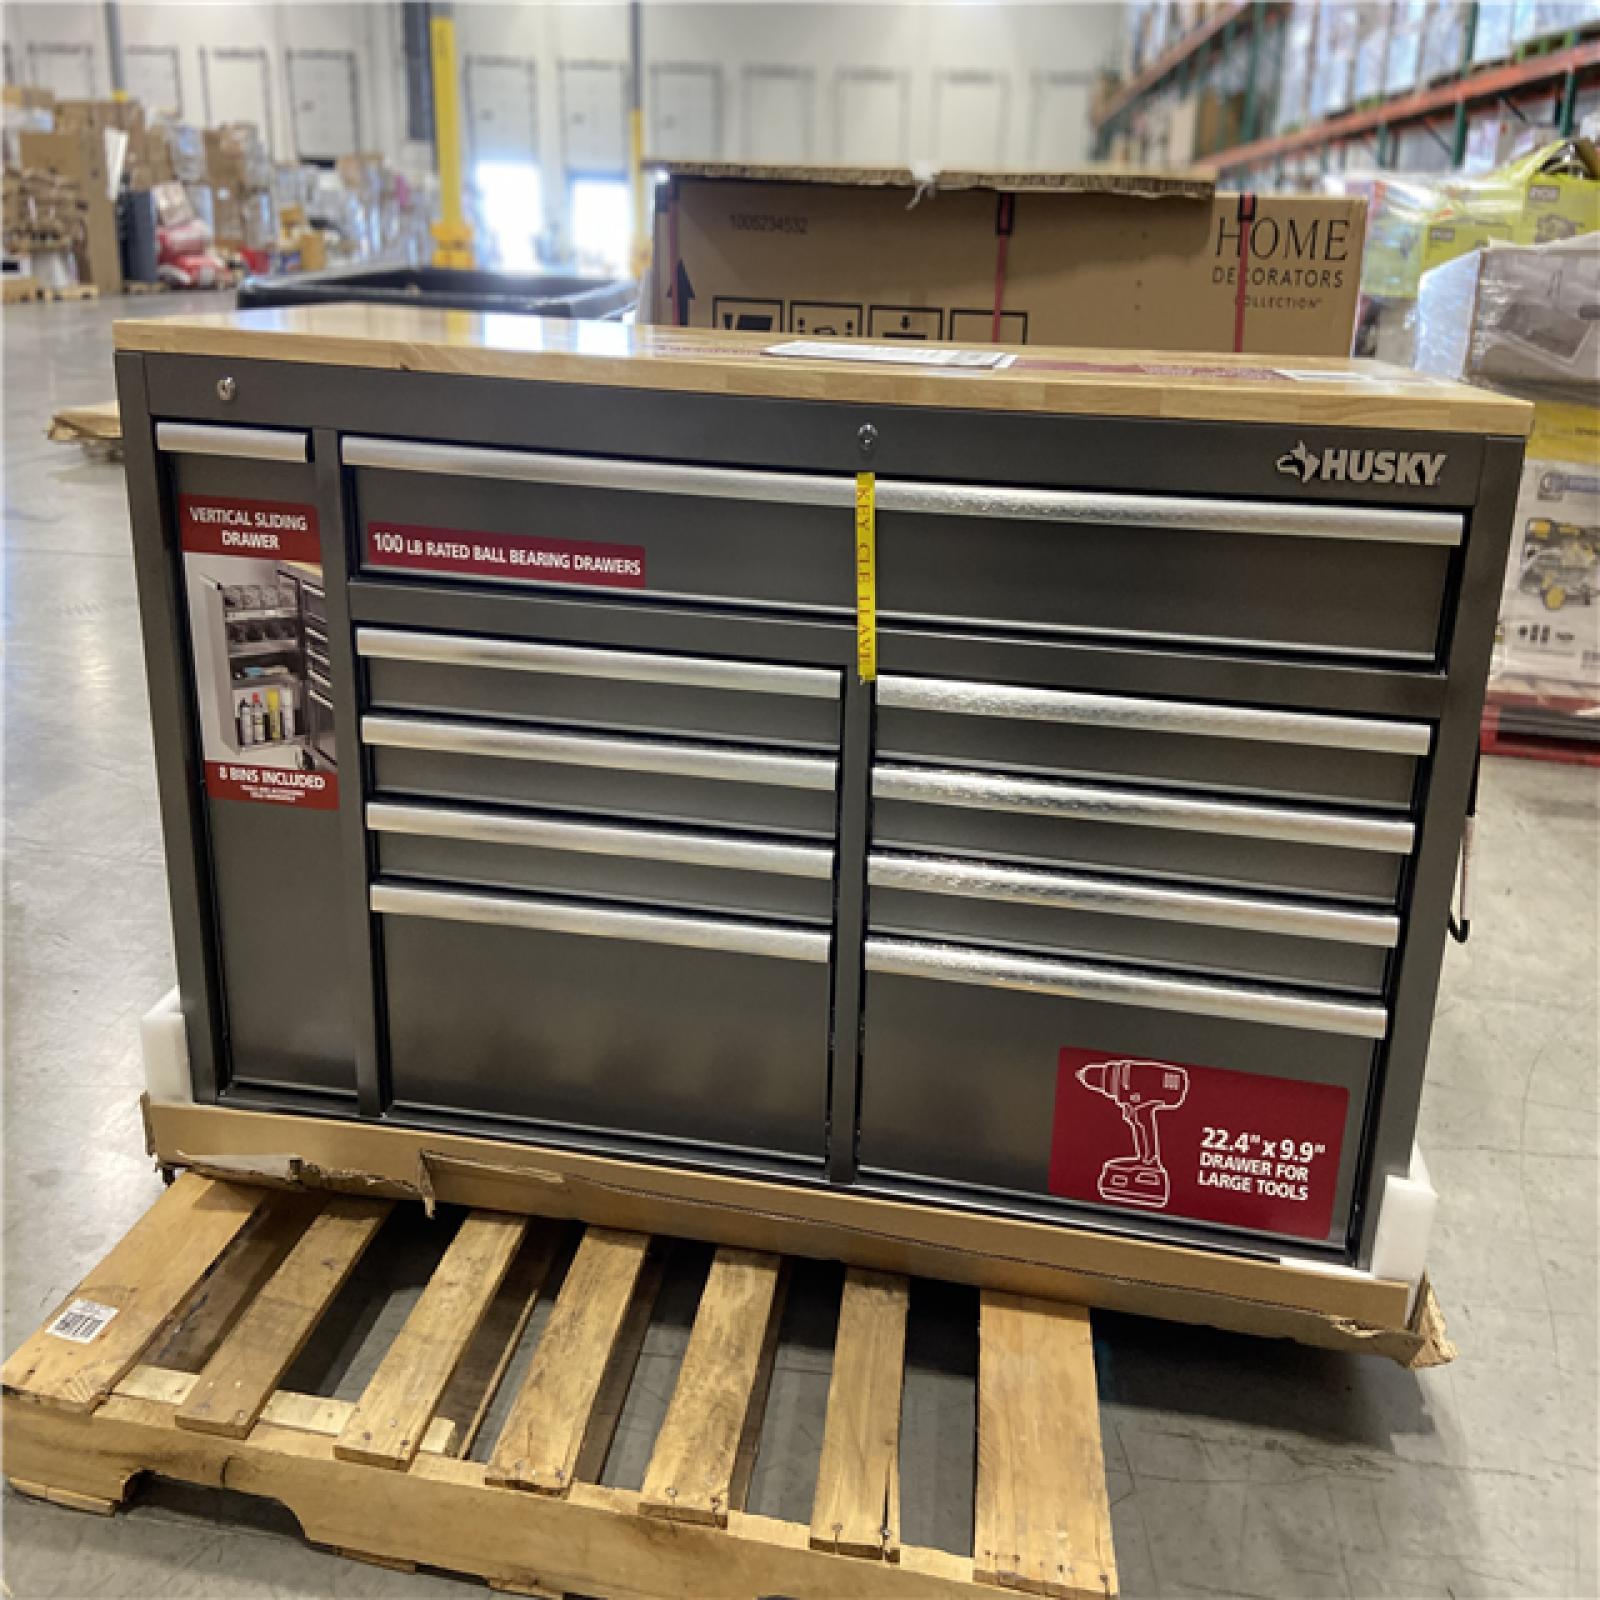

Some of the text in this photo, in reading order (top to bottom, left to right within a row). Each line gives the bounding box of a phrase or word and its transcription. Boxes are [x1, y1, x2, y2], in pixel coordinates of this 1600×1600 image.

[1215, 216, 1349, 260] HOME
[1321, 447, 1448, 486] HUSKY
[190, 507, 308, 531] VERTICAL SLIDING
[222, 530, 280, 550] DRAWER
[373, 532, 641, 576] 100 LB RATED BALL BEARING DRAWERS
[229, 767, 259, 783] BINS
[262, 770, 325, 789] INCLUDED
[1201, 1127, 1260, 1152] 22.4"
[1280, 1139, 1326, 1163] 9.9"
[1200, 1153, 1309, 1181] DRAWER FOR
[1198, 1170, 1309, 1200] LARGE TOOLS
